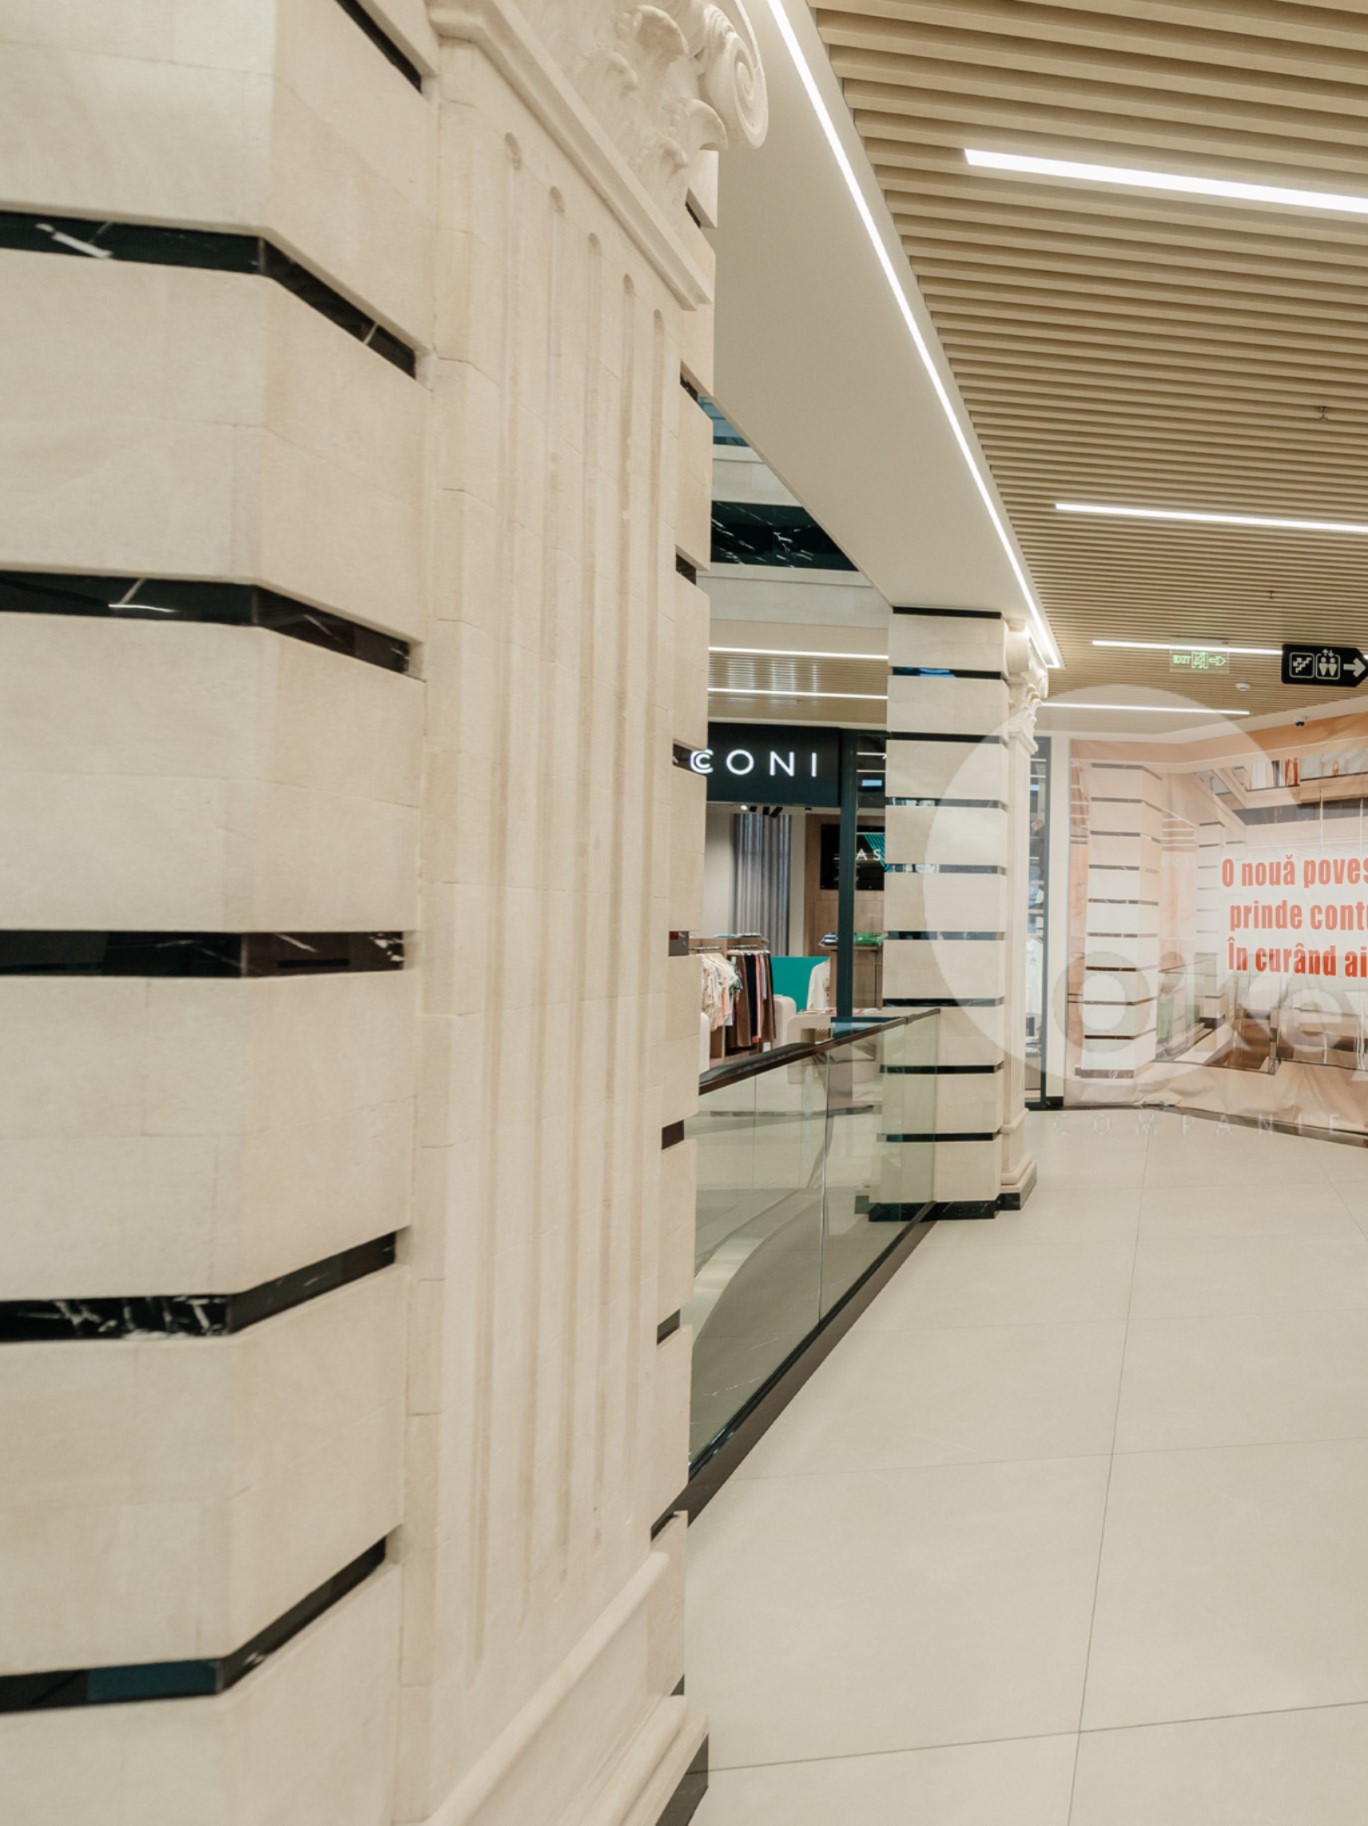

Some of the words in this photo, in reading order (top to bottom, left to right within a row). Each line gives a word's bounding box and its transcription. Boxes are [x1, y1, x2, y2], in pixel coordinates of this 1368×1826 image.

[1221, 857, 1235, 888] O
[1240, 853, 1297, 887] nouă
[1229, 899, 1304, 932] prinde
[1227, 935, 1249, 972] În
[1255, 941, 1338, 977] curând
